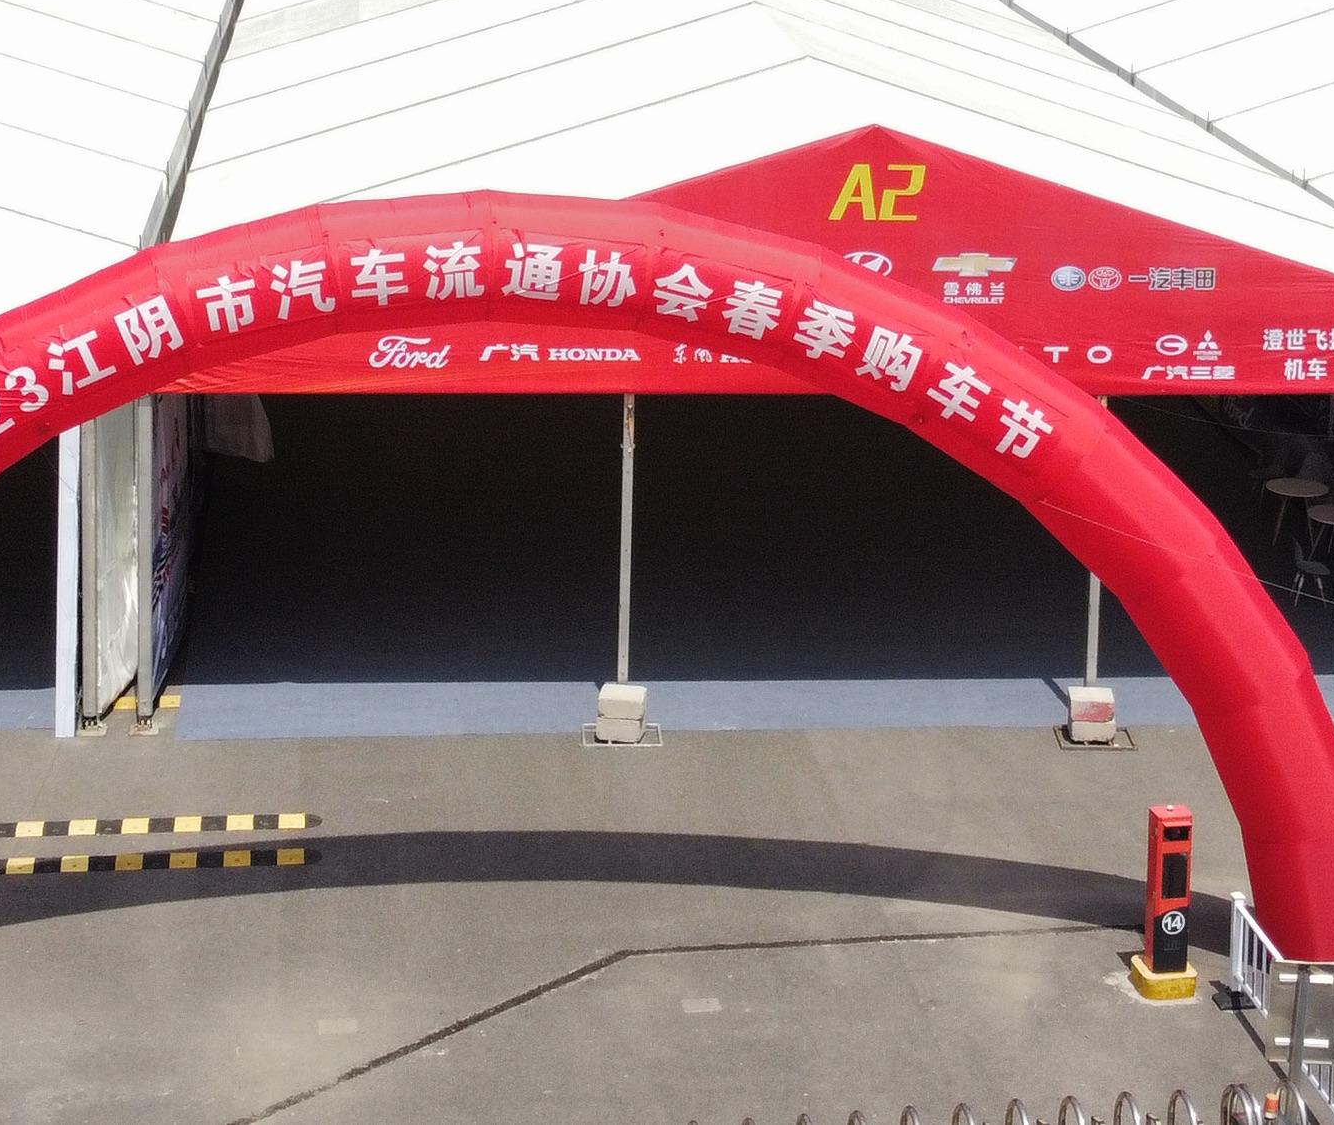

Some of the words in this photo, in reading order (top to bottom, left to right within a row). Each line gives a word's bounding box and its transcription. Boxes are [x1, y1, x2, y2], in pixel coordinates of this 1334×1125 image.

[828, 163, 926, 222] A2
[1127, 267, 1216, 291] 一汽丰田
[943, 282, 1005, 296] 雪佛兰
[942, 296, 1005, 304] CHEVROLET
[368, 335, 451, 369] Ford
[479, 343, 540, 362] 广汽
[547, 348, 642, 362] HONDA
[1141, 366, 1236, 380] 广汽三菱
[1283, 358, 1328, 380] 机车
[1164, 915, 1182, 931] 14
